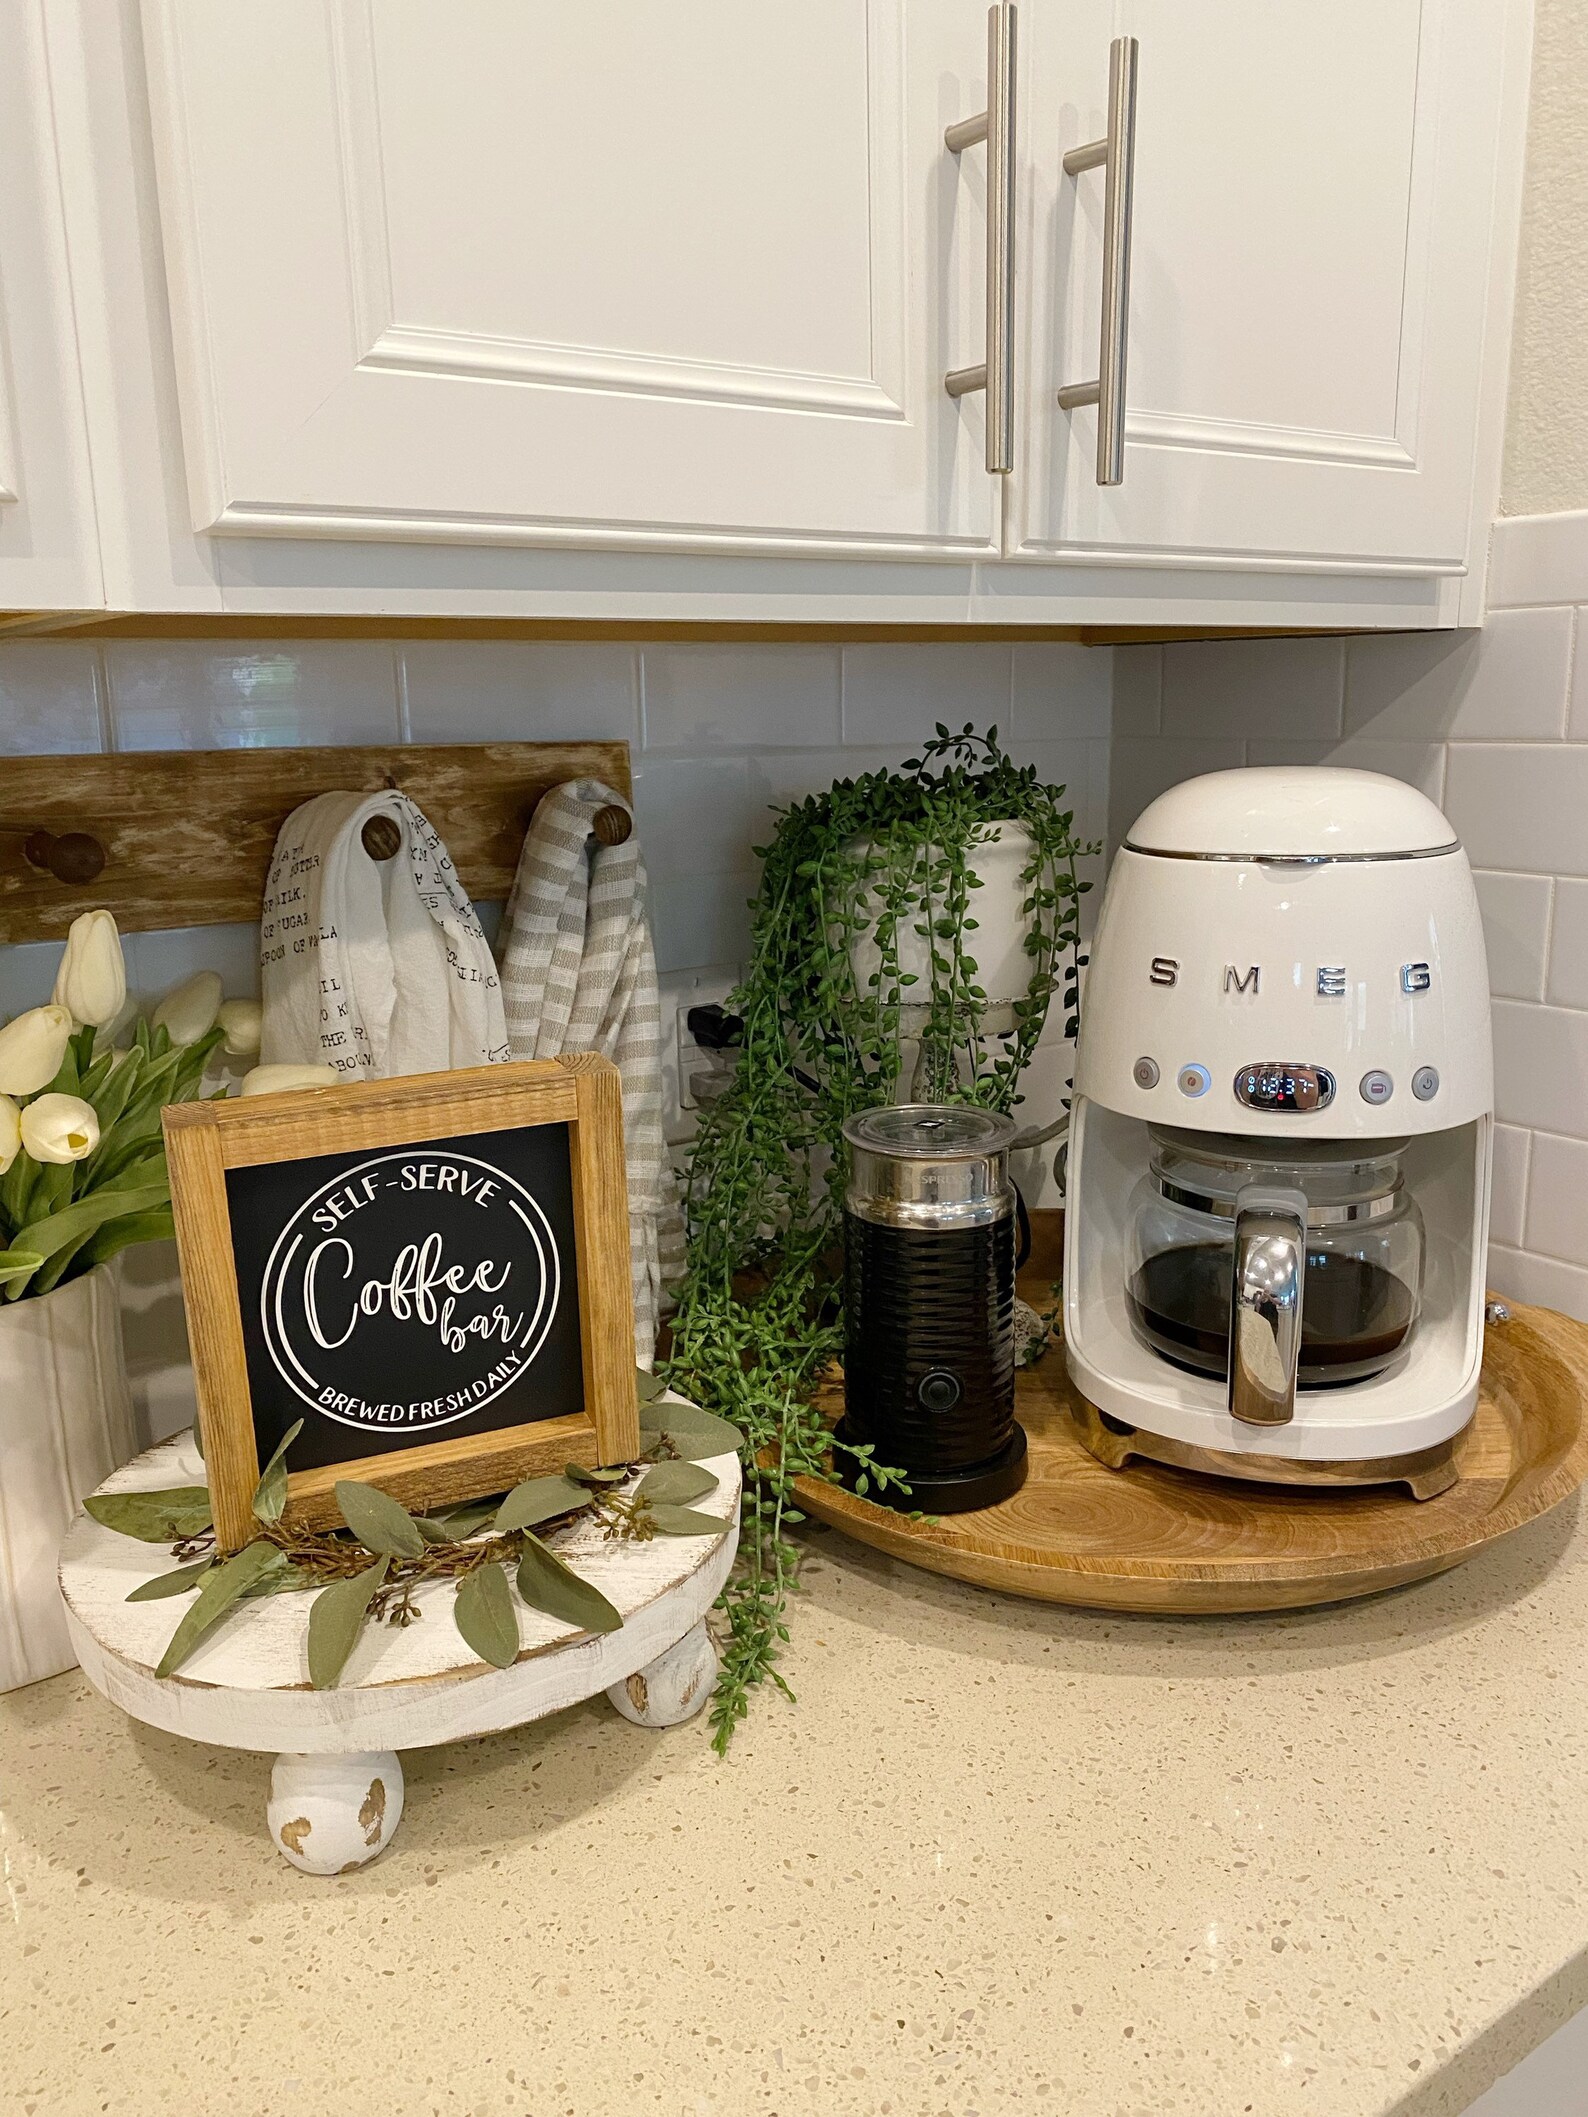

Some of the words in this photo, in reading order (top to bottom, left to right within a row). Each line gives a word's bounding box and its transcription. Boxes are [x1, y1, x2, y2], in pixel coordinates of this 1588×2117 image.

[1149, 956, 1432, 996] SMEG
[311, 1163, 502, 1233] SELF-SERVE
[303, 1232, 512, 1349] Coffee
[439, 1296, 524, 1353] bar
[317, 1386, 405, 1422] BREWED
[408, 1387, 473, 1422] FRESH
[472, 1350, 523, 1399] DAILY
